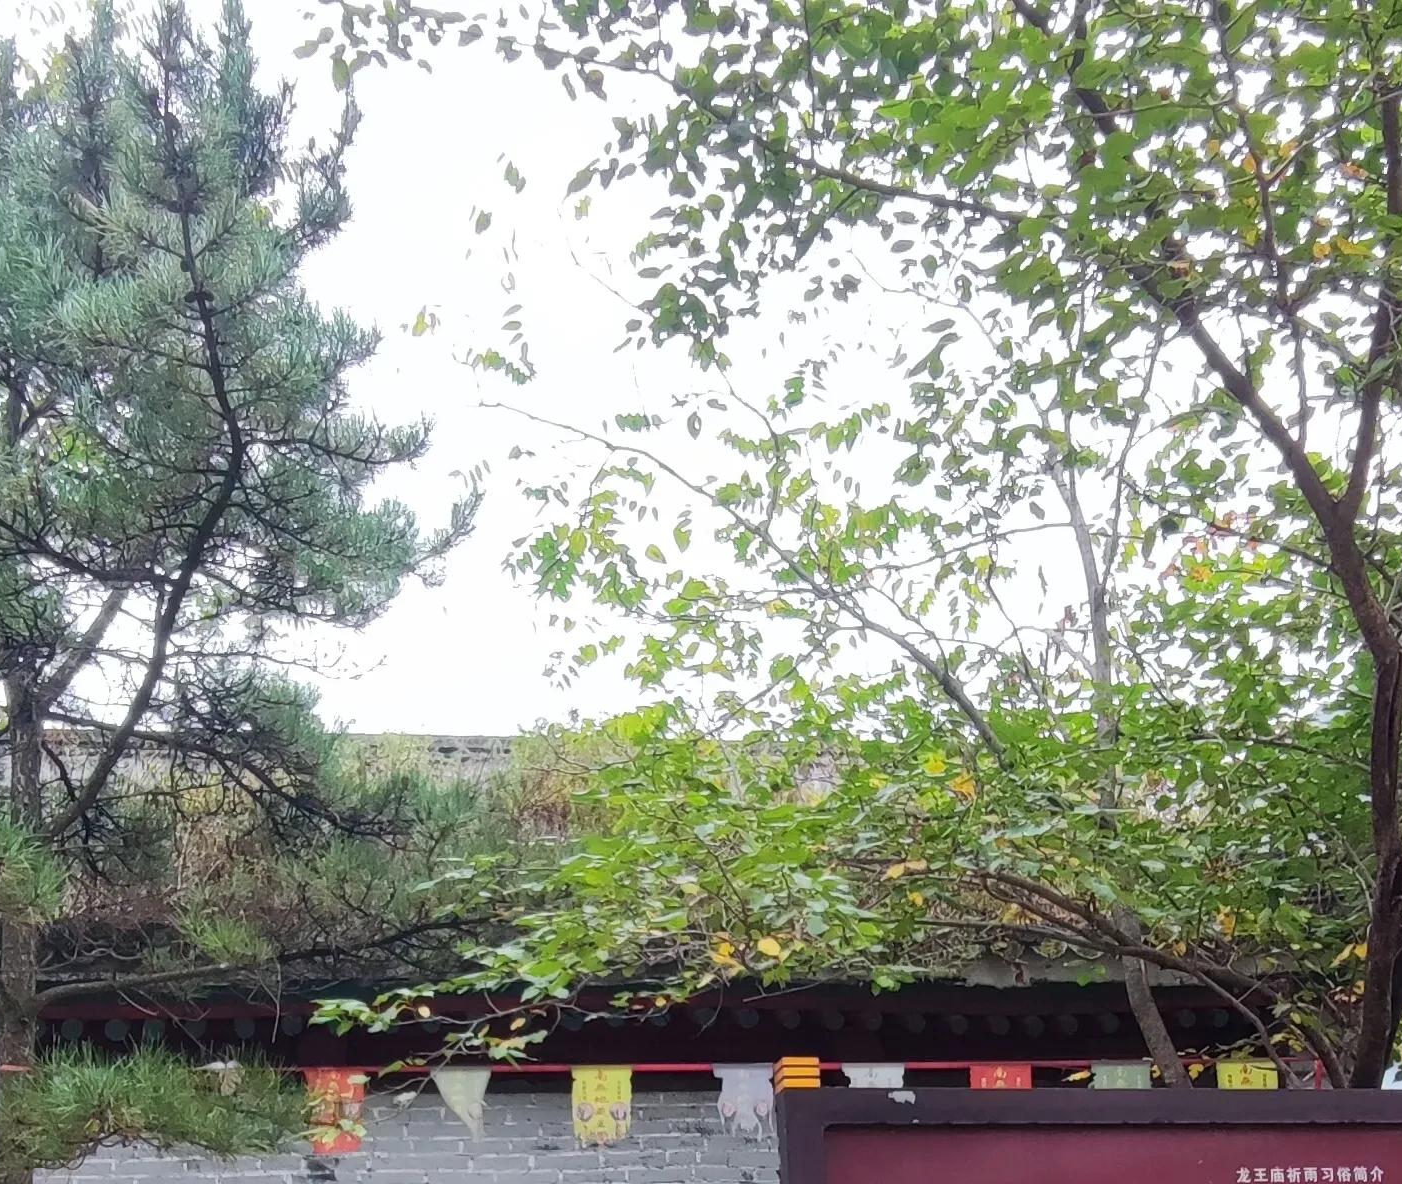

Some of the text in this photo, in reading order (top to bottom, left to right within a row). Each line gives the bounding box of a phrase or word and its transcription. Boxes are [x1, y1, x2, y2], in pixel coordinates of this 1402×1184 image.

[1236, 1167, 1384, 1184] 龙王庙祈雨习俗简介
